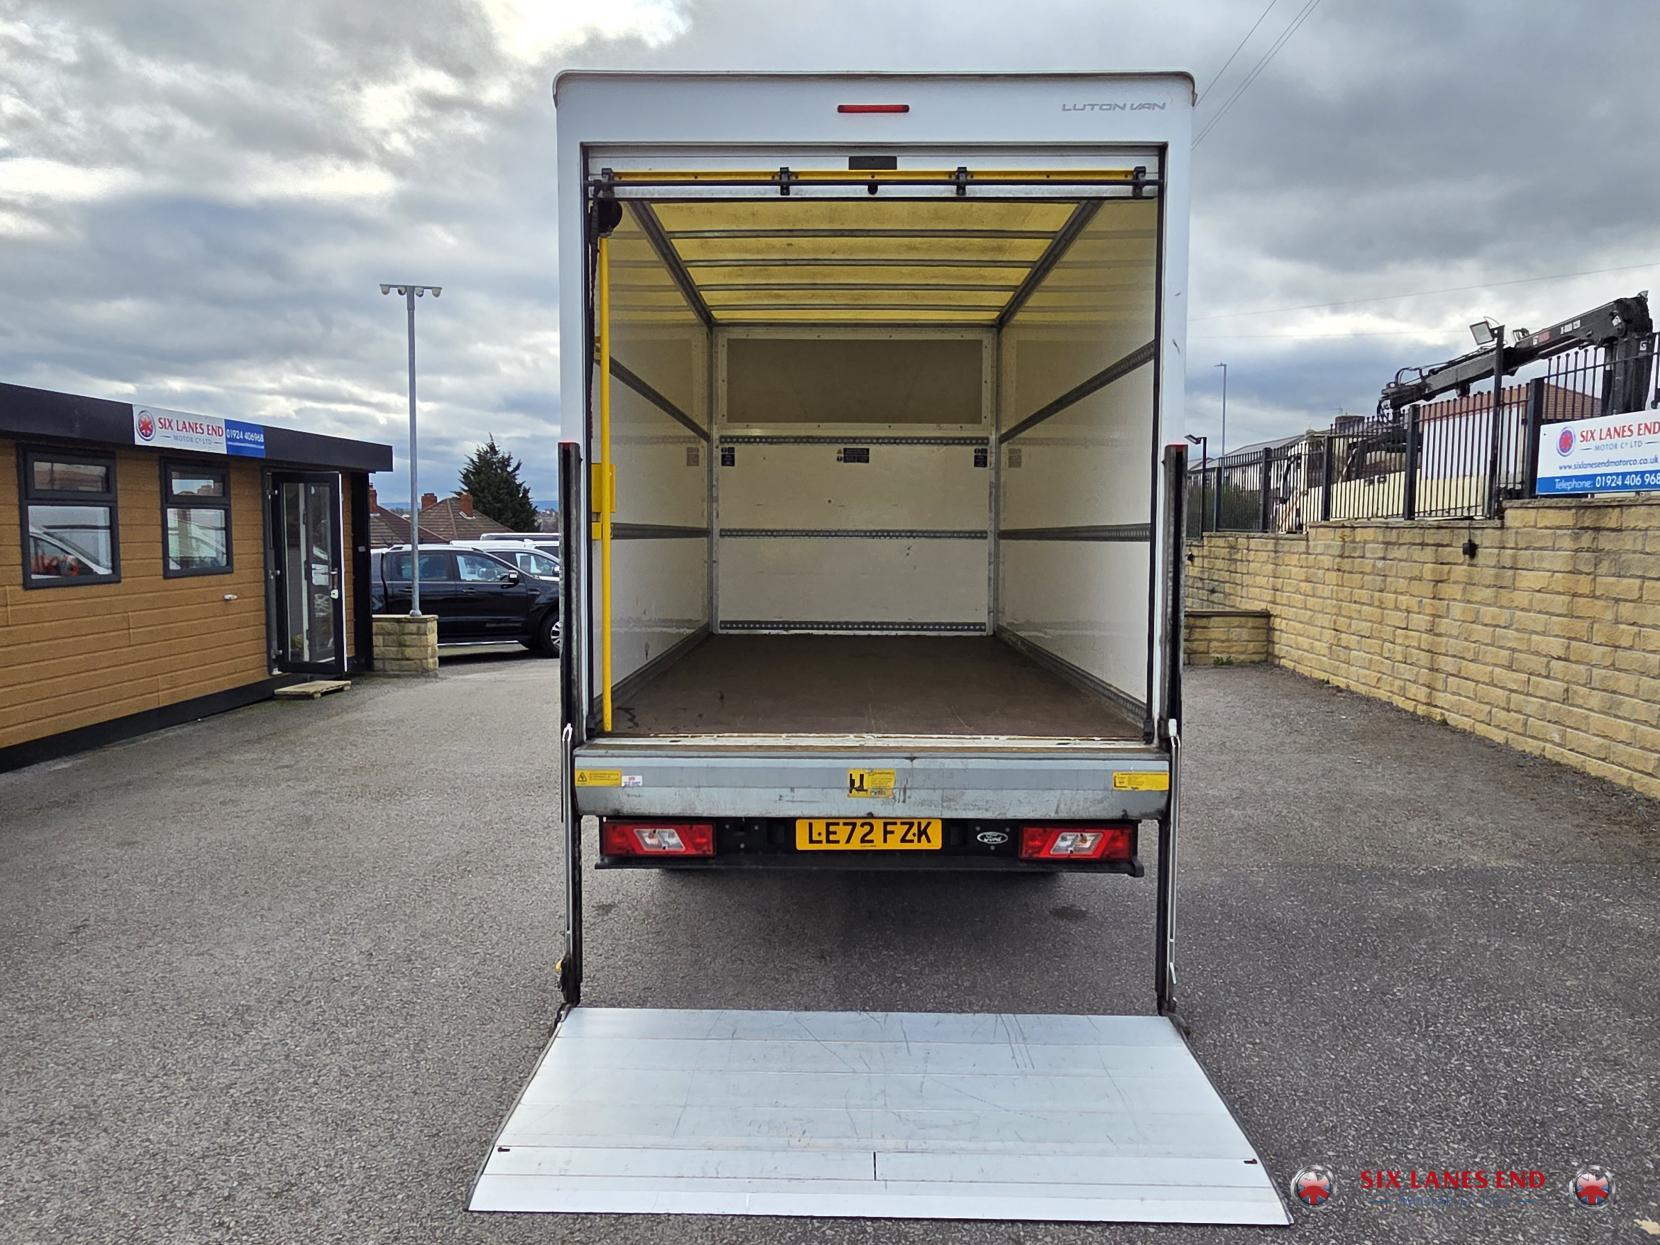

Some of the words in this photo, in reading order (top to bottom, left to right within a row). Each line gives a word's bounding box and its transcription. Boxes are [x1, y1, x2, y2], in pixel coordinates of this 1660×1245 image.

[1062, 103, 1127, 111] LUTON
[1130, 102, 1166, 110] VAN
[158, 417, 173, 430] SIX
[176, 420, 204, 434] LANES
[207, 424, 224, 437] END
[226, 428, 244, 439] 01924
[1579, 429, 1596, 443] SIX
[1599, 424, 1634, 441] LANES
[1637, 421, 1660, 436] END
[1595, 443, 1618, 451] MOTOR
[1630, 441, 1643, 449] LTD
[1555, 478, 1593, 491] Telephone:
[1595, 476, 1622, 488] 01924
[1624, 474, 1642, 486] 406
[1644, 473, 1660, 485] 968
[808, 821, 875, 844] LE72
[882, 821, 932, 844] FZK
[980, 832, 1004, 843] Ford
